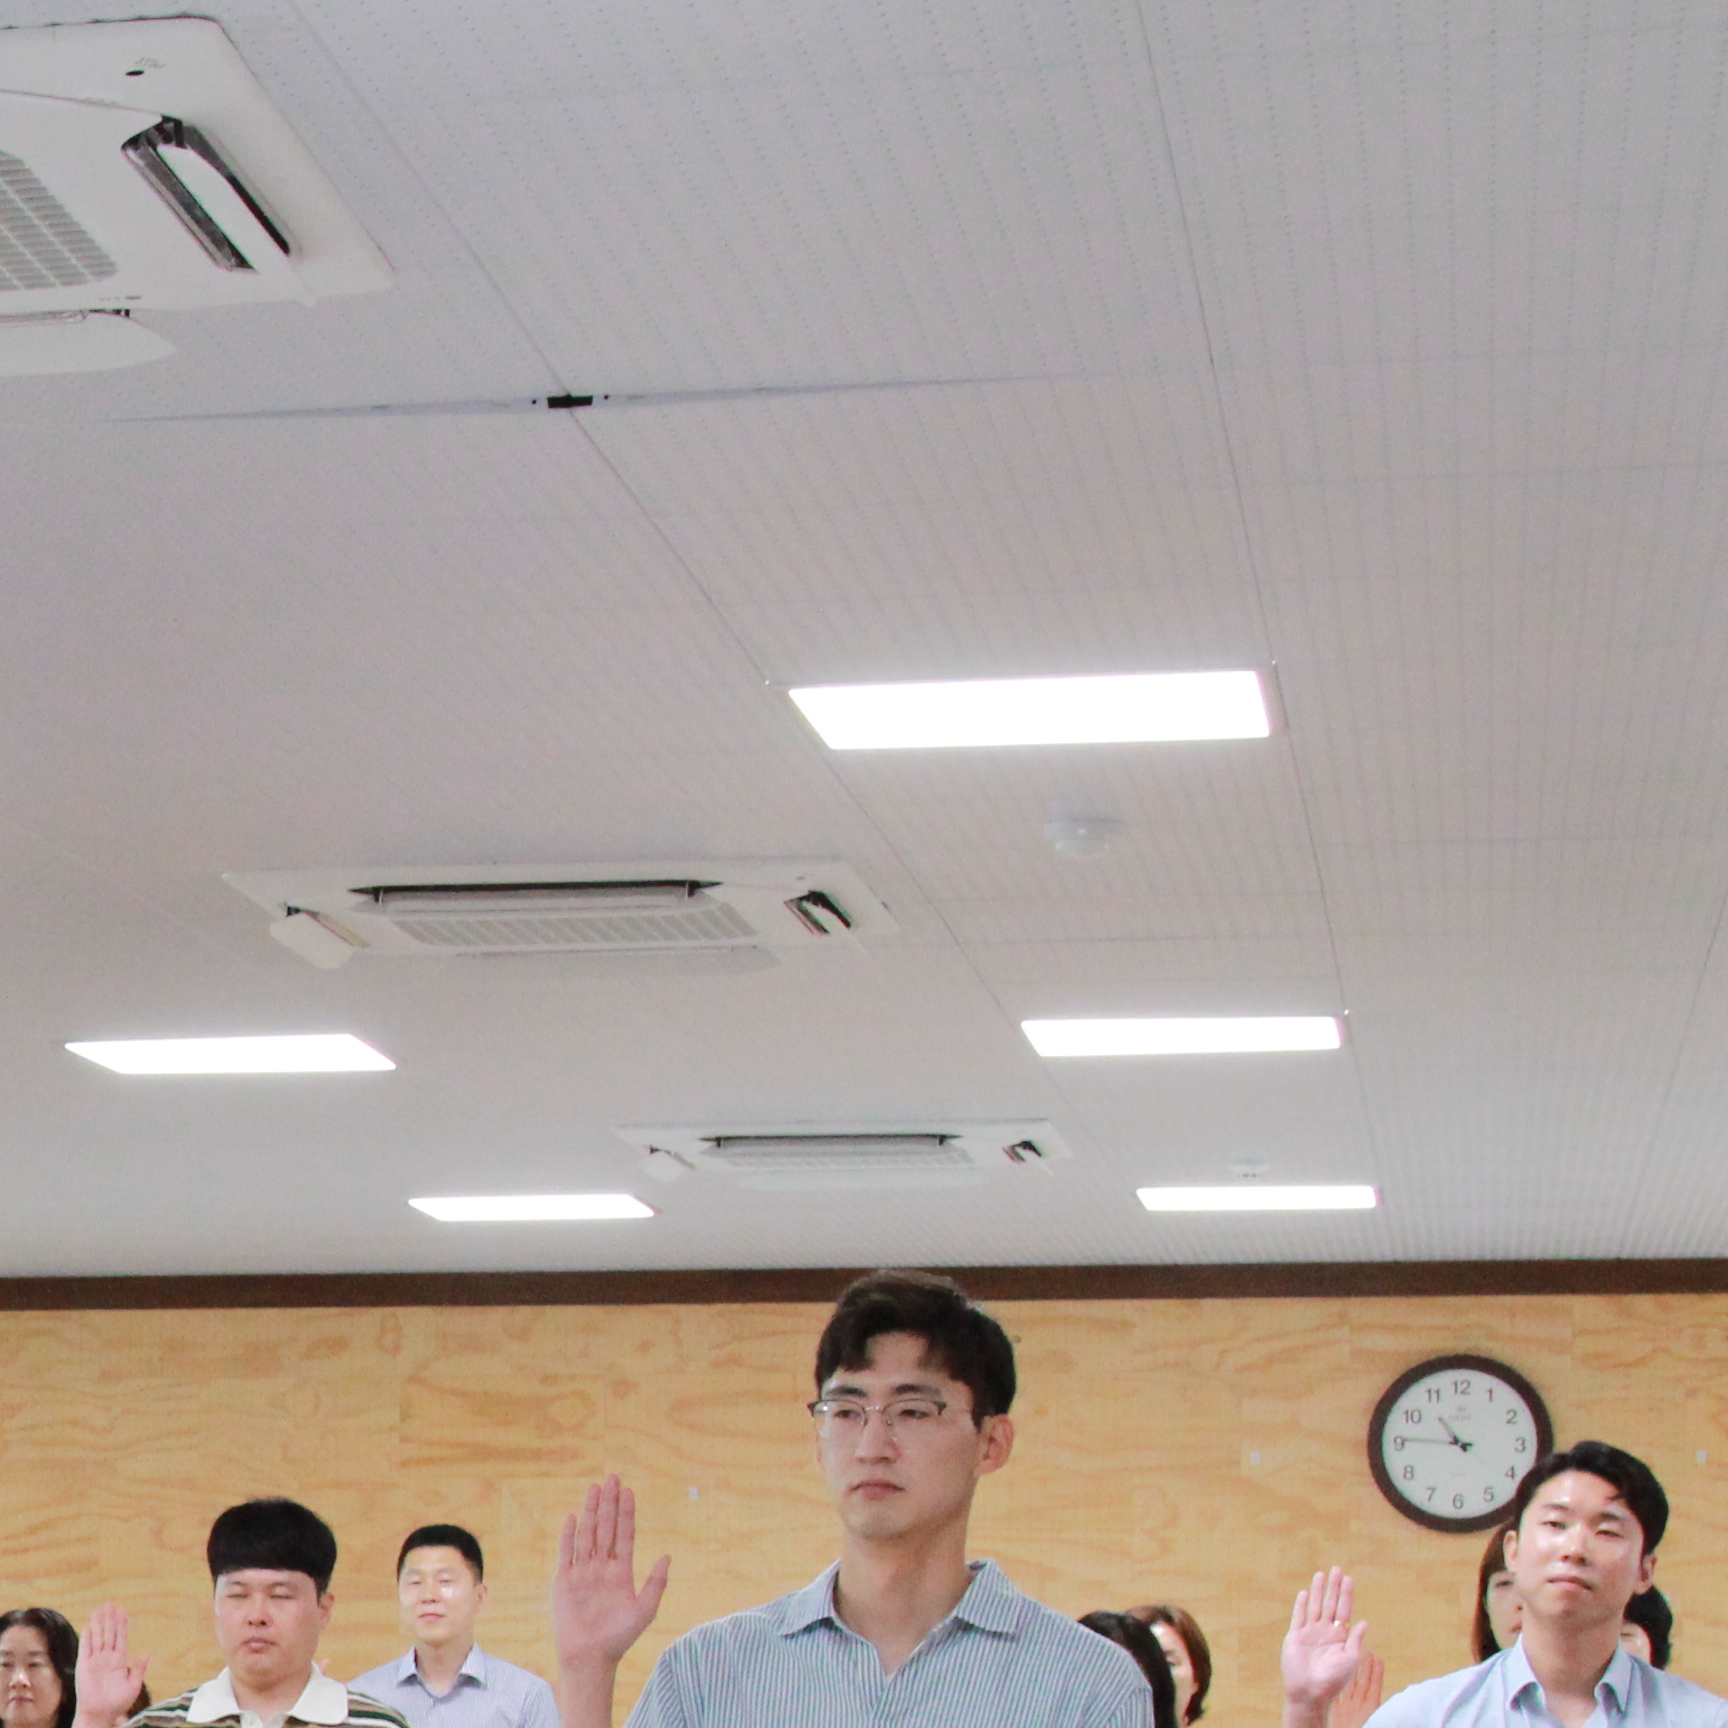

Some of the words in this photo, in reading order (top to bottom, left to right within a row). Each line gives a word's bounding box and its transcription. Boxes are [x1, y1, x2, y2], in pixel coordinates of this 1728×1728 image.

[1452, 1380, 1471, 1395] 12
[1486, 1388, 1493, 1402] 1
[1425, 1388, 1440, 1403] 11
[1404, 1409, 1422, 1424] 10
[1506, 1409, 1517, 1424] 2
[1394, 1435, 1405, 1451] 9
[1515, 1437, 1526, 1452] 3
[1403, 1465, 1414, 1480] 8
[1505, 1466, 1516, 1479] 4
[1426, 1487, 1437, 1502] 7
[1453, 1494, 1464, 1509] 6
[1484, 1487, 1494, 1502] 5
